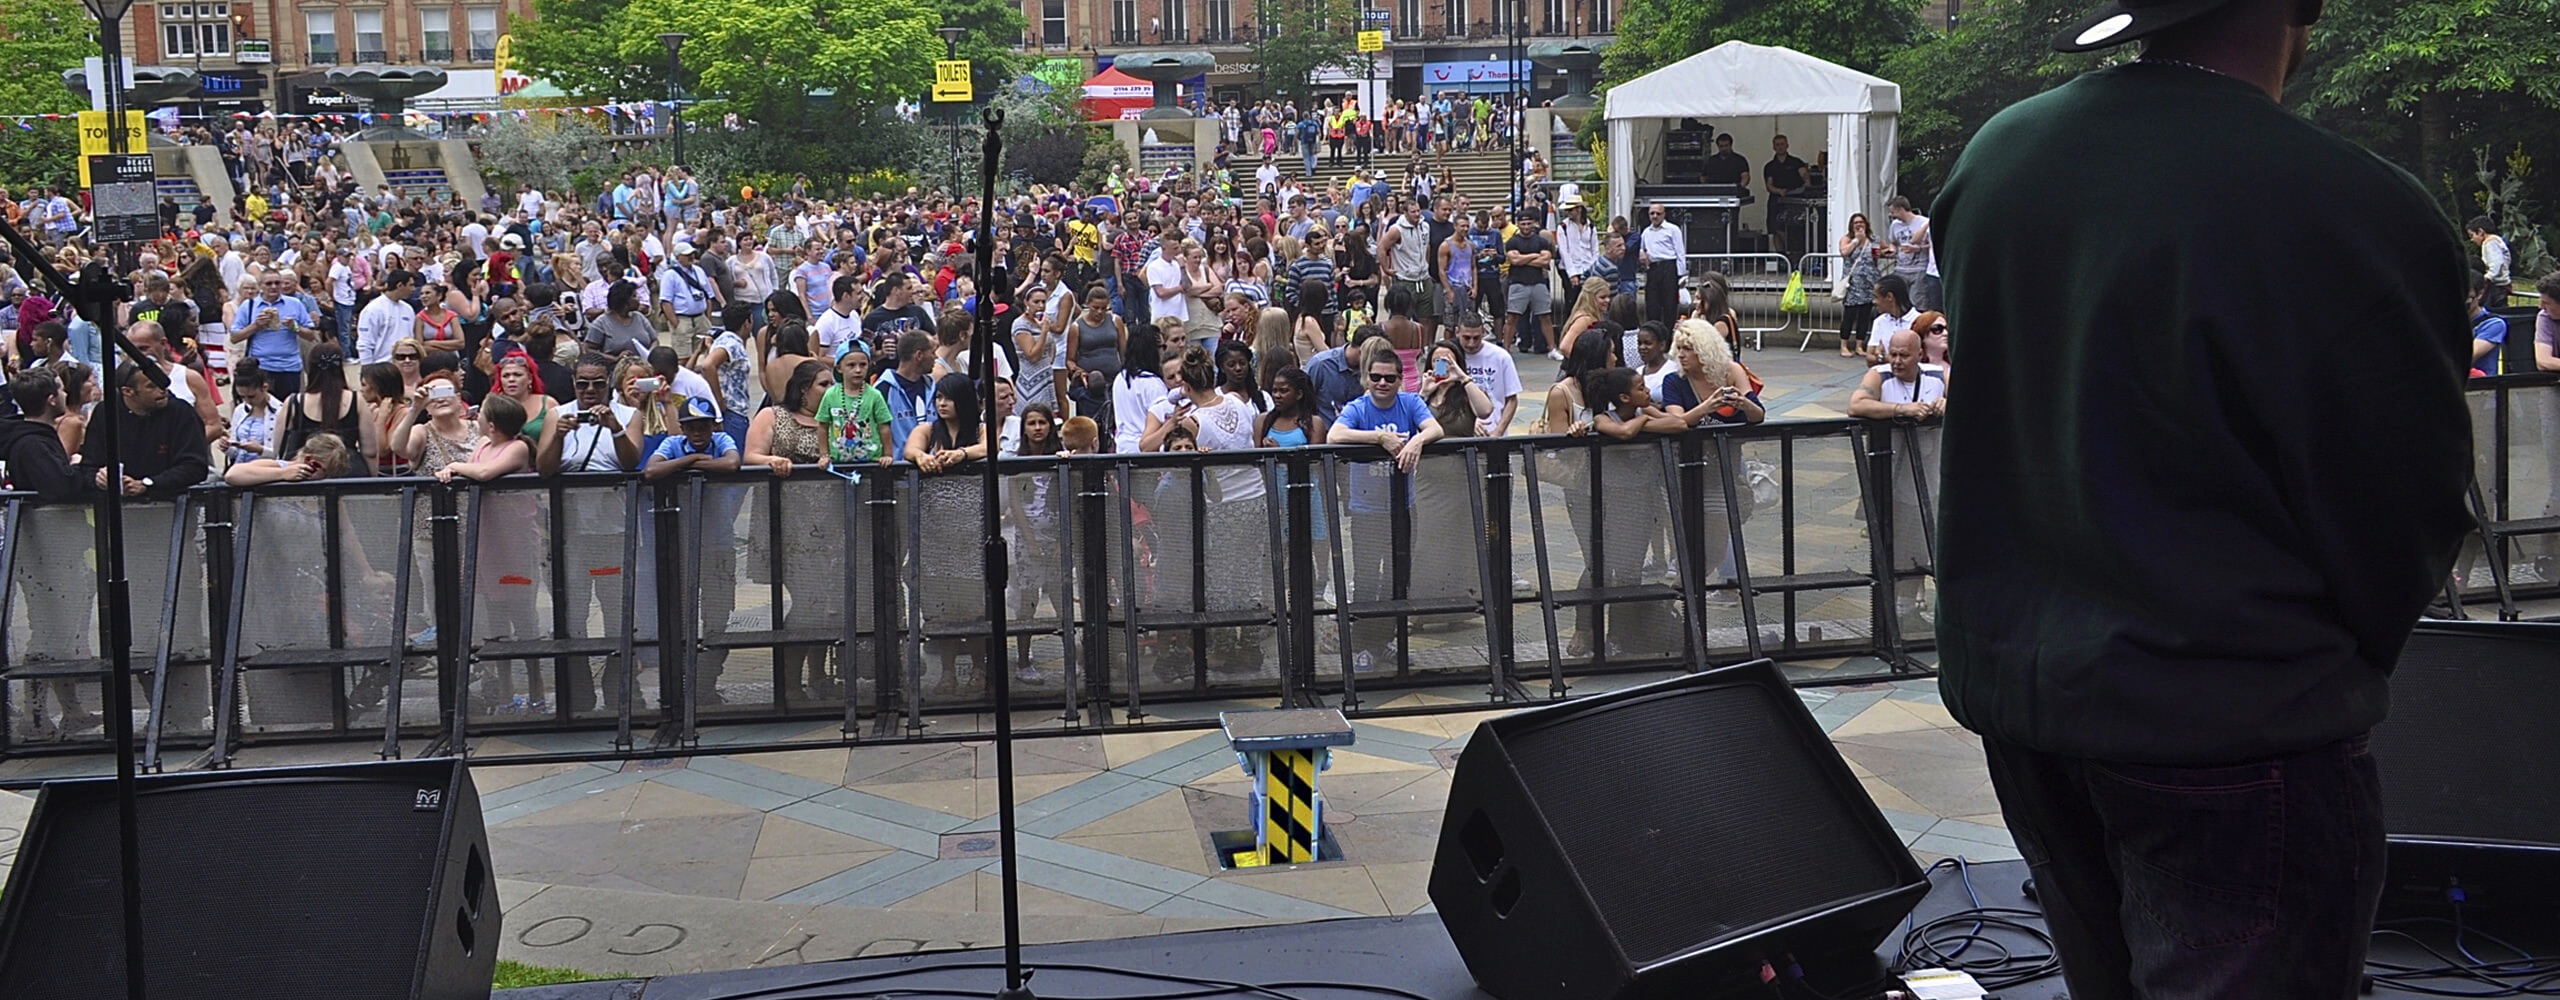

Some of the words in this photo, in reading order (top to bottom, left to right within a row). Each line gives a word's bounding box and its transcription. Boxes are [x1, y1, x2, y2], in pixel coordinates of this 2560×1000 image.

[938, 63, 968, 82] TOILETS
[308, 95, 343, 106] Proper
[127, 158, 152, 166] PEACE
[117, 165, 153, 174] GARDENS
